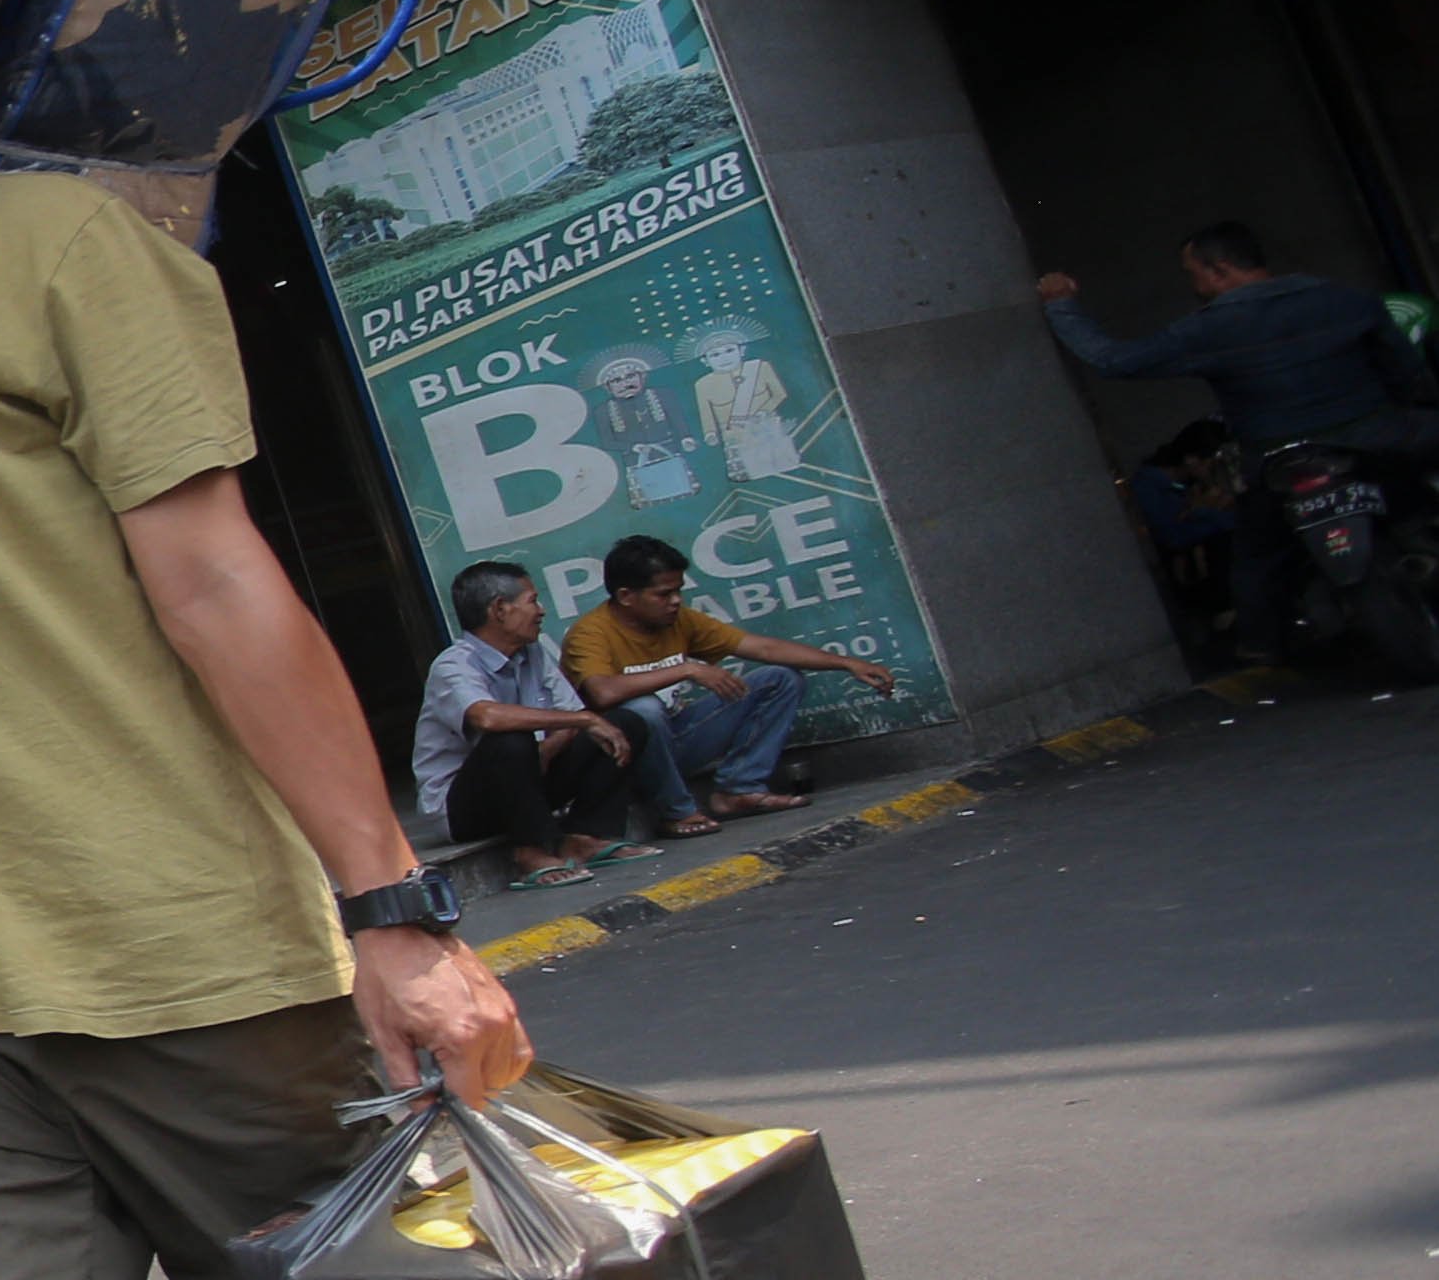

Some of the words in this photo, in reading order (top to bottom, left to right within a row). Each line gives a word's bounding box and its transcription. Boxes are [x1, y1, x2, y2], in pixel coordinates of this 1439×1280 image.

[361, 300, 401, 338] DI
[414, 232, 553, 306] PUSAT
[562, 151, 743, 246] GROSIR
[368, 301, 474, 359] PASAR
[478, 242, 601, 308] TANAH
[609, 176, 746, 253] ABANG
[408, 332, 568, 408] BLOK
[420, 383, 619, 553] B
